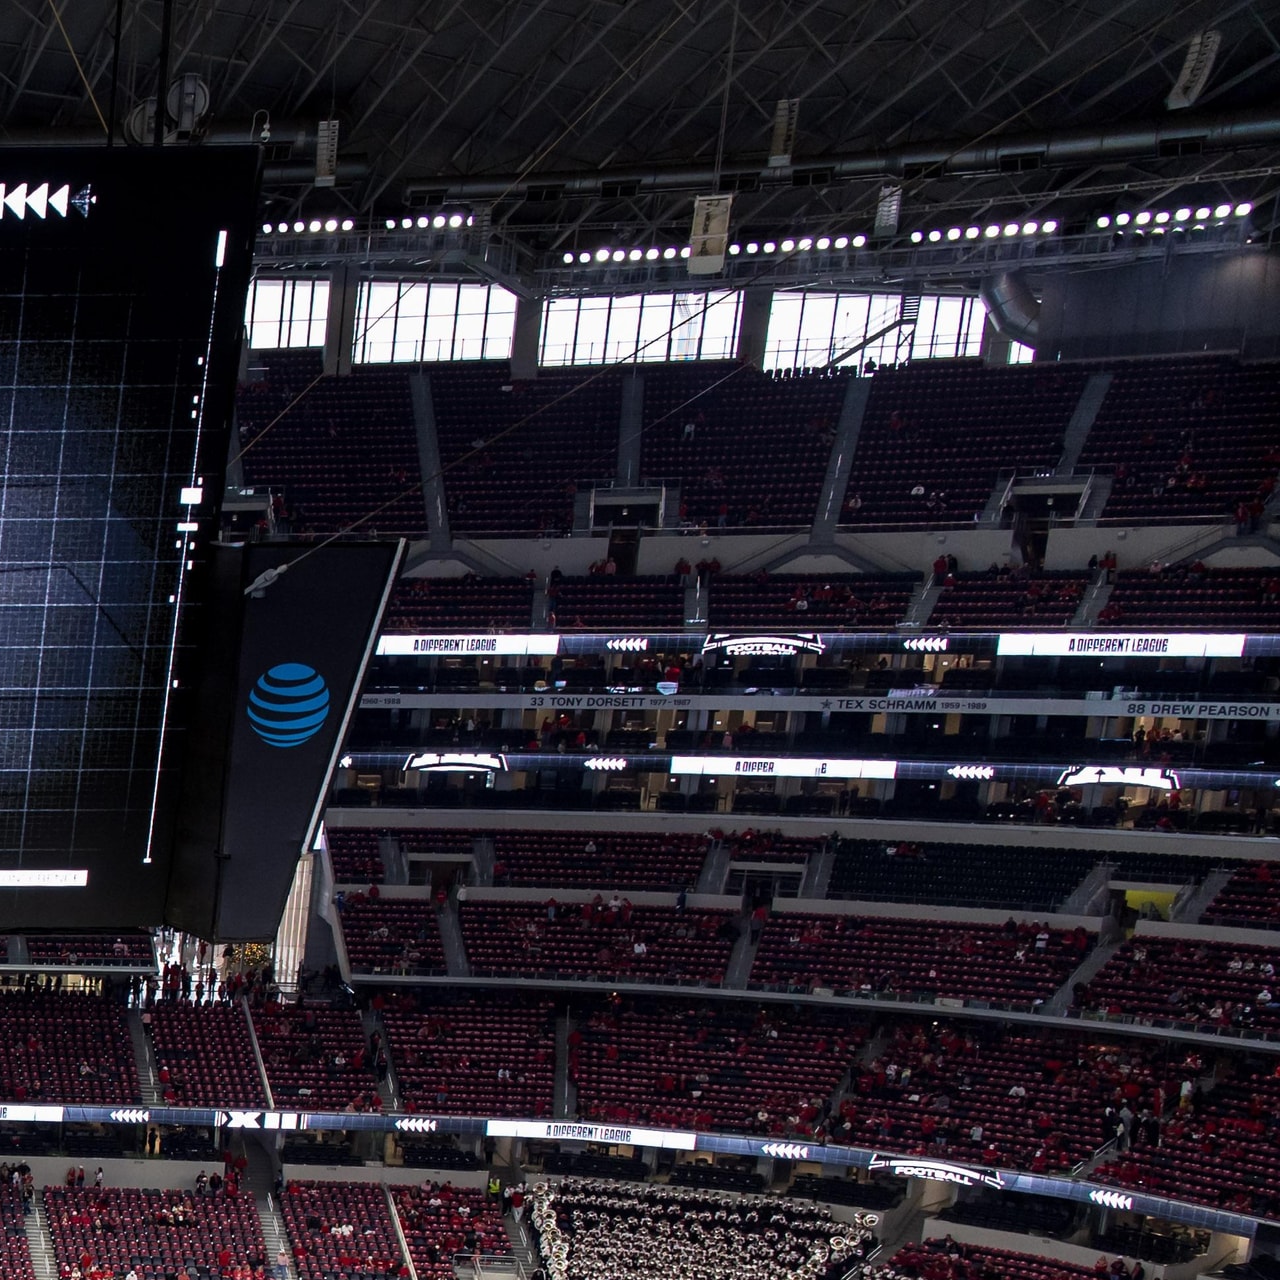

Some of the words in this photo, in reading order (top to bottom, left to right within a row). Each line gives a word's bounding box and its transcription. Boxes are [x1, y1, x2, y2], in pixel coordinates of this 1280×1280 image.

[414, 639, 419, 651] A
[420, 639, 465, 651] DIFFERENT
[466, 639, 497, 651] LEAGUE
[1069, 638, 1075, 651] A
[1077, 638, 1130, 652] DIFFERENT
[1132, 639, 1168, 652] LEAGUE
[530, 697, 544, 706] 33
[550, 697, 583, 706] TONY
[587, 697, 645, 707] DORSETT
[837, 699, 864, 709] TEX
[869, 700, 936, 710] SCHRAMM
[1127, 703, 1145, 714] 88
[1151, 704, 1194, 715] DREW
[1199, 705, 1269, 717] PEARSON
[546, 1124, 552, 1137] A
[553, 1125, 598, 1141] DIFFERENT
[600, 1128, 631, 1143] LEAGUE
[895, 1165, 972, 1185] FOOTBALL
